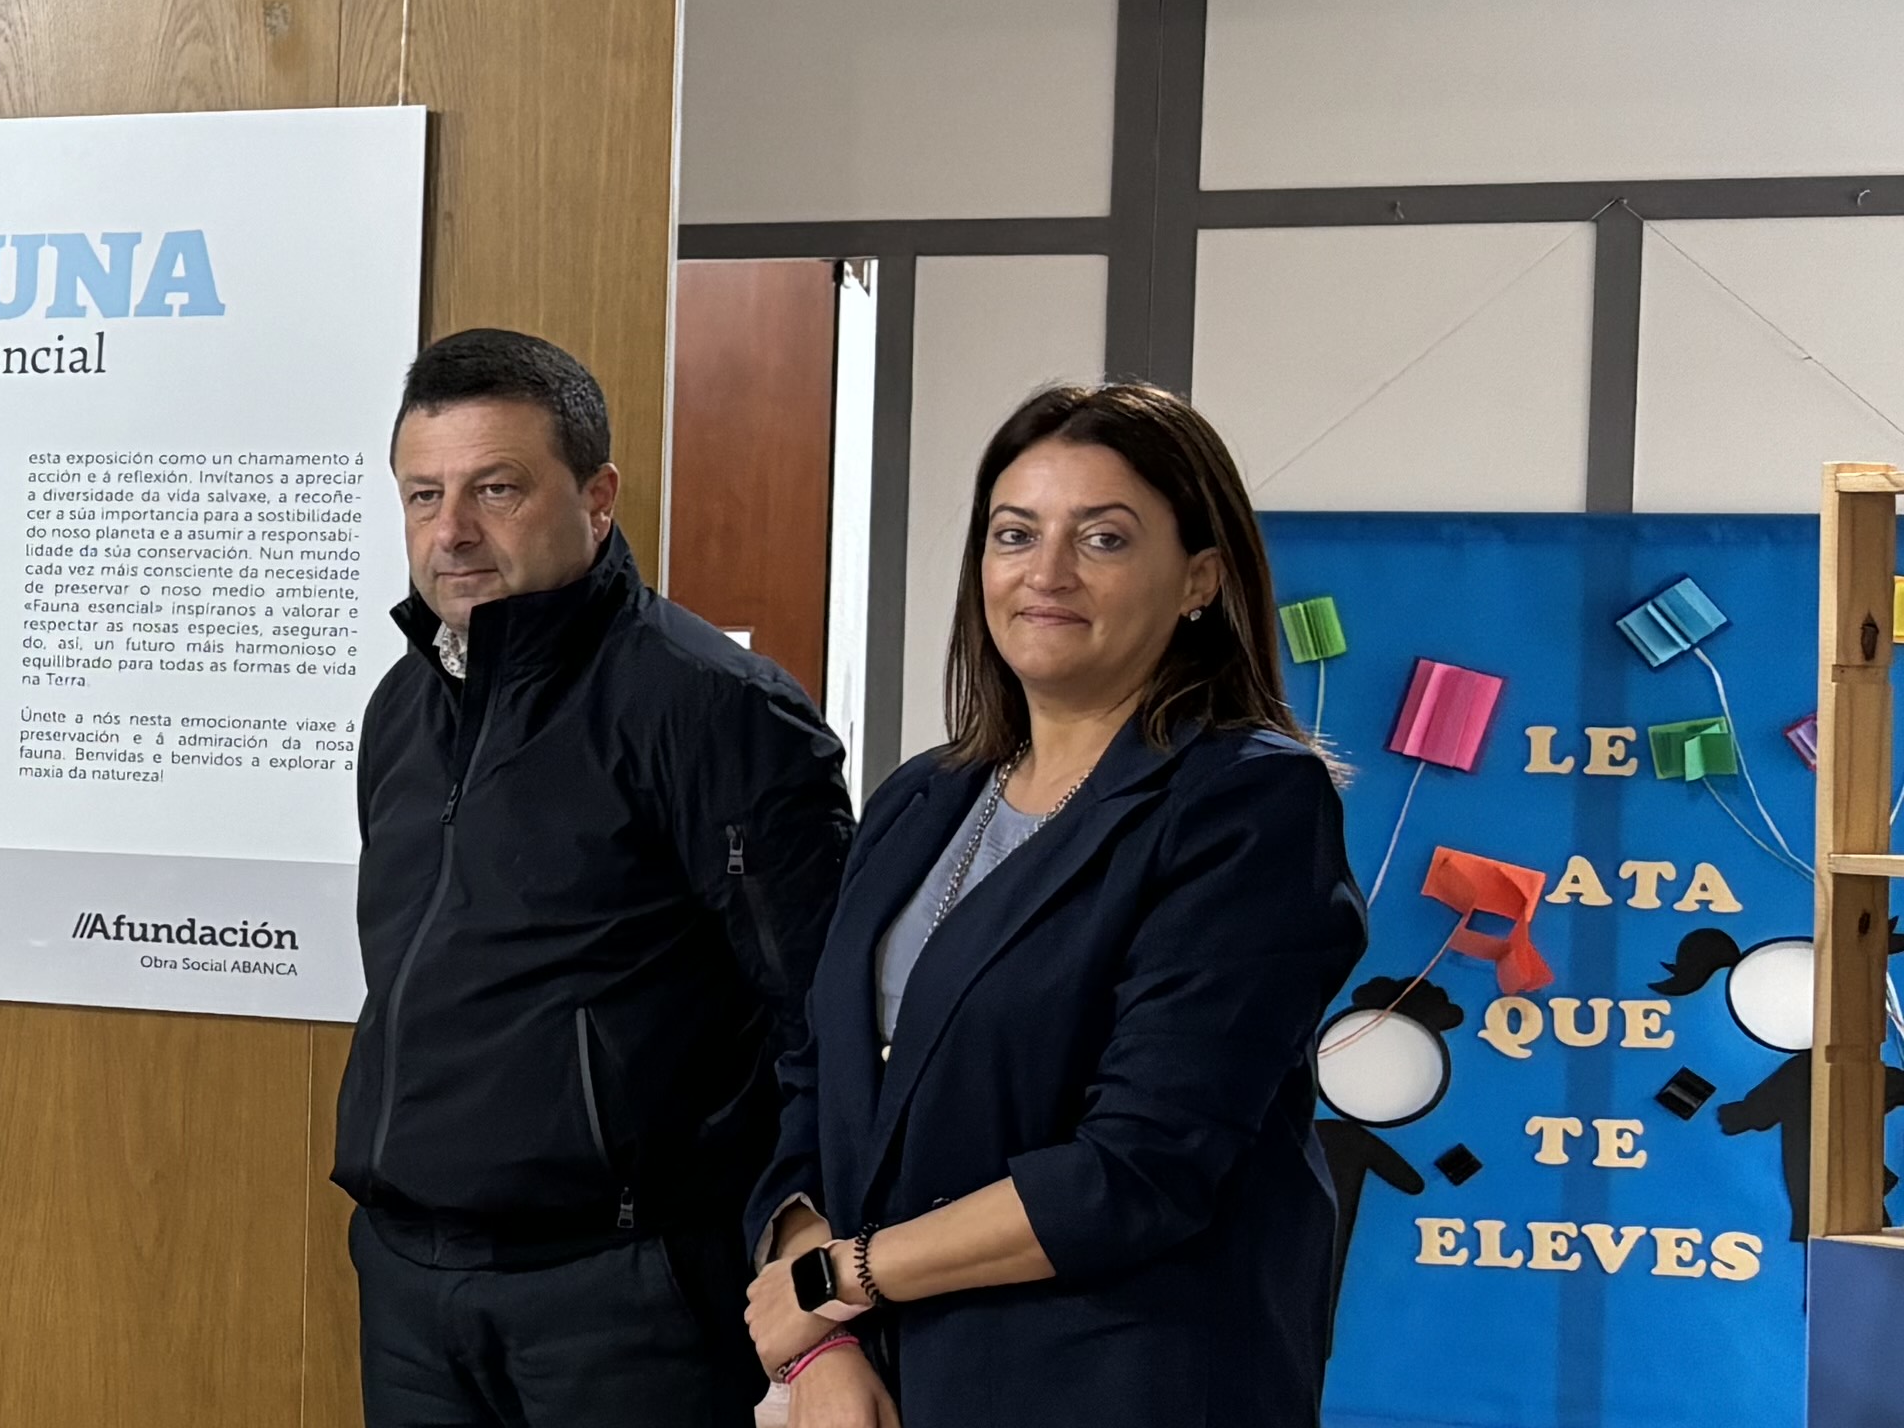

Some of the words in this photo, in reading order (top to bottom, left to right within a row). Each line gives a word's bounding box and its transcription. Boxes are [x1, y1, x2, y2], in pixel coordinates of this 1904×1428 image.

[28, 452, 61, 464] esta
[66, 451, 154, 468] exposición
[158, 454, 207, 465] como
[211, 454, 233, 465] un
[238, 452, 350, 467] chamamento
[28, 469, 81, 483] acción
[86, 472, 97, 483] e
[199, 470, 274, 484] Invítanos
[279, 473, 289, 484] a
[295, 470, 364, 487] apreciar
[26, 509, 52, 521] cer
[54, 509, 65, 520] a
[69, 506, 96, 520] súa
[101, 506, 199, 524] importancia
[203, 511, 239, 525] para
[242, 511, 253, 522] a
[257, 508, 362, 524] sostibilidade
[21, 705, 67, 724] Únete
[73, 713, 84, 724] a
[93, 711, 121, 725] nós
[129, 713, 172, 726] nesta
[180, 715, 288, 730] emocionante
[296, 717, 337, 732] viaxe
[20, 727, 120, 748] preservación
[132, 734, 143, 746] e
[178, 732, 268, 750] admiración
[280, 735, 302, 750] da
[316, 740, 354, 752] nosa
[1524, 726, 1638, 777] LE
[19, 745, 66, 760] fauna.
[75, 747, 145, 764] Benvidas
[151, 753, 163, 764] e
[171, 750, 243, 766] benvidos
[250, 756, 260, 767] a
[269, 754, 336, 772] explorar
[343, 760, 353, 770] a
[140, 955, 177, 970] Obra
[182, 957, 227, 973] Social
[230, 960, 298, 977] ABANCA
[1477, 996, 1675, 1059] QUE
[1525, 1116, 1648, 1169] TE
[1415, 1217, 1763, 1281] ELEVES
